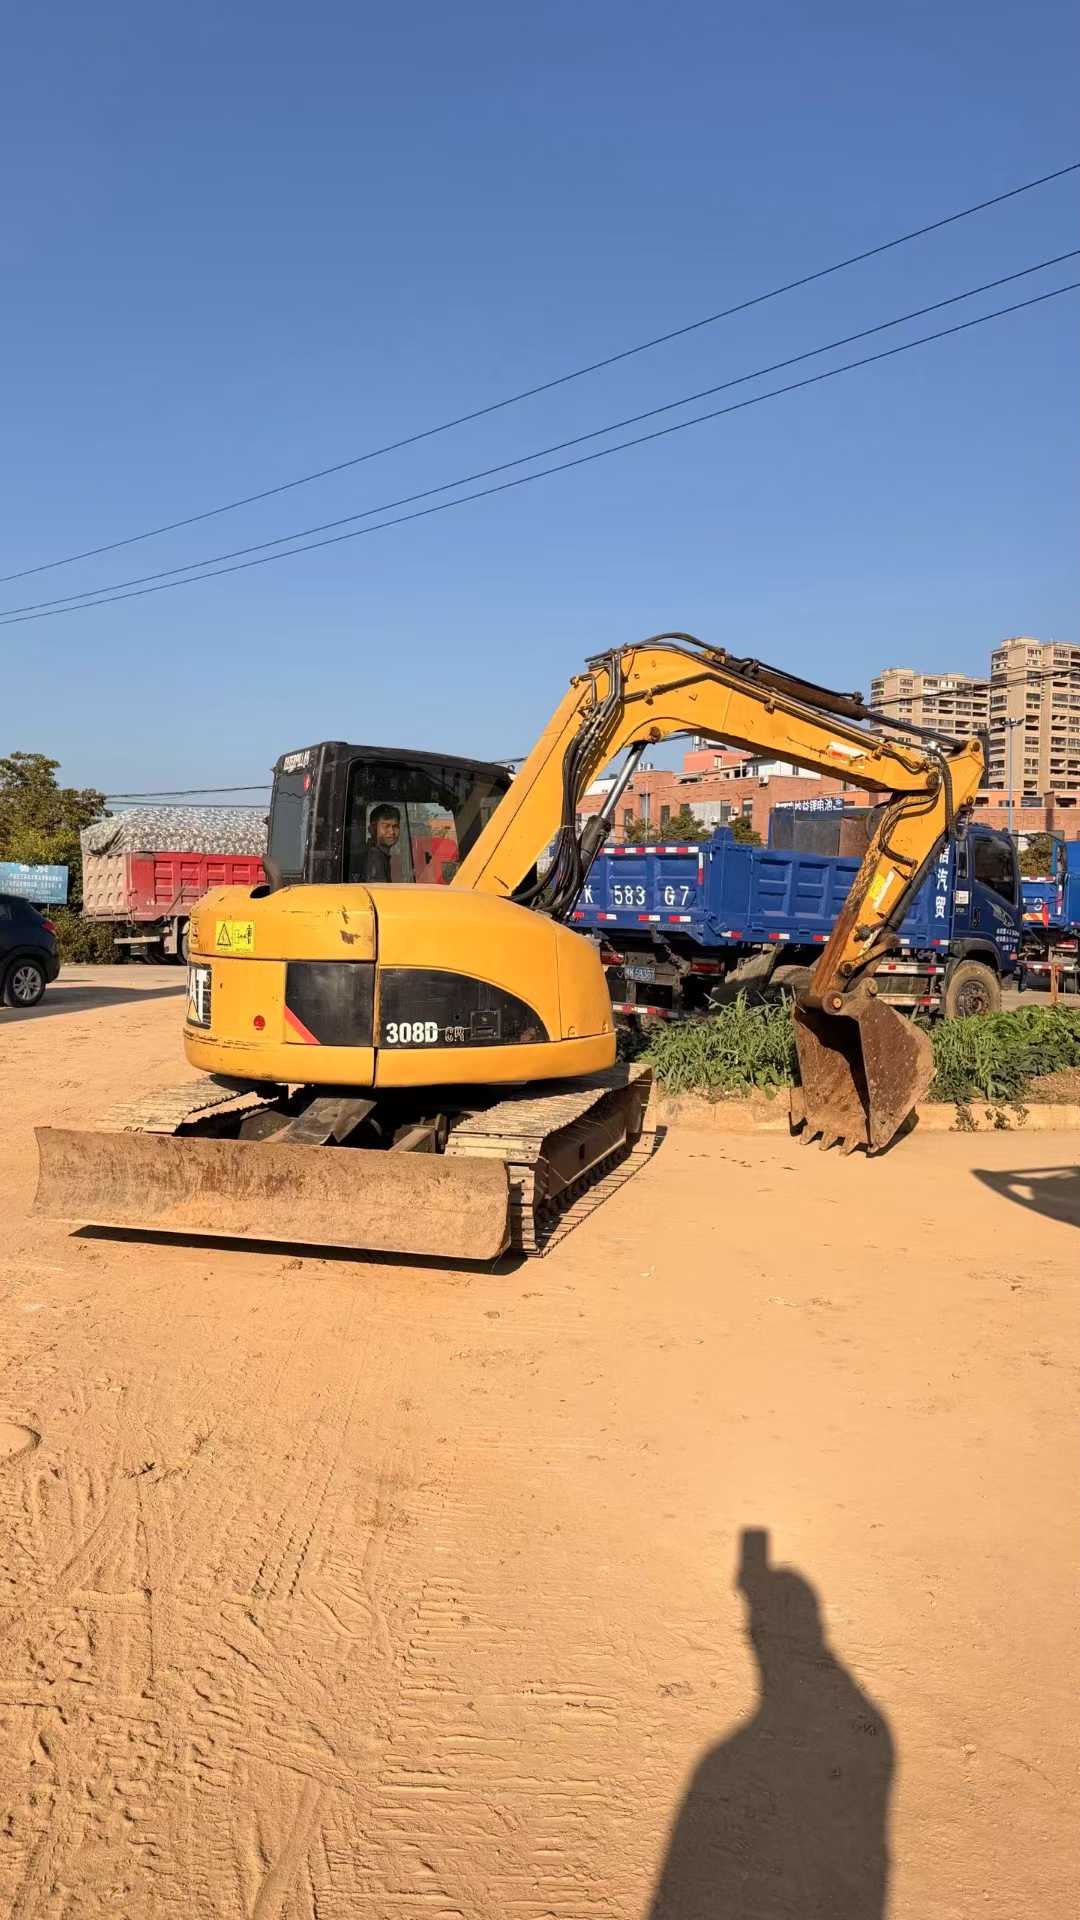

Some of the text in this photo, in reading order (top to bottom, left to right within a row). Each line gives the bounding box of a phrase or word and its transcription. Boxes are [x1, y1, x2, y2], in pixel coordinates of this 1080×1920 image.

[614, 884, 646, 905] 583
[664, 885, 690, 906] G7
[386, 1021, 465, 1044] 308D CR
